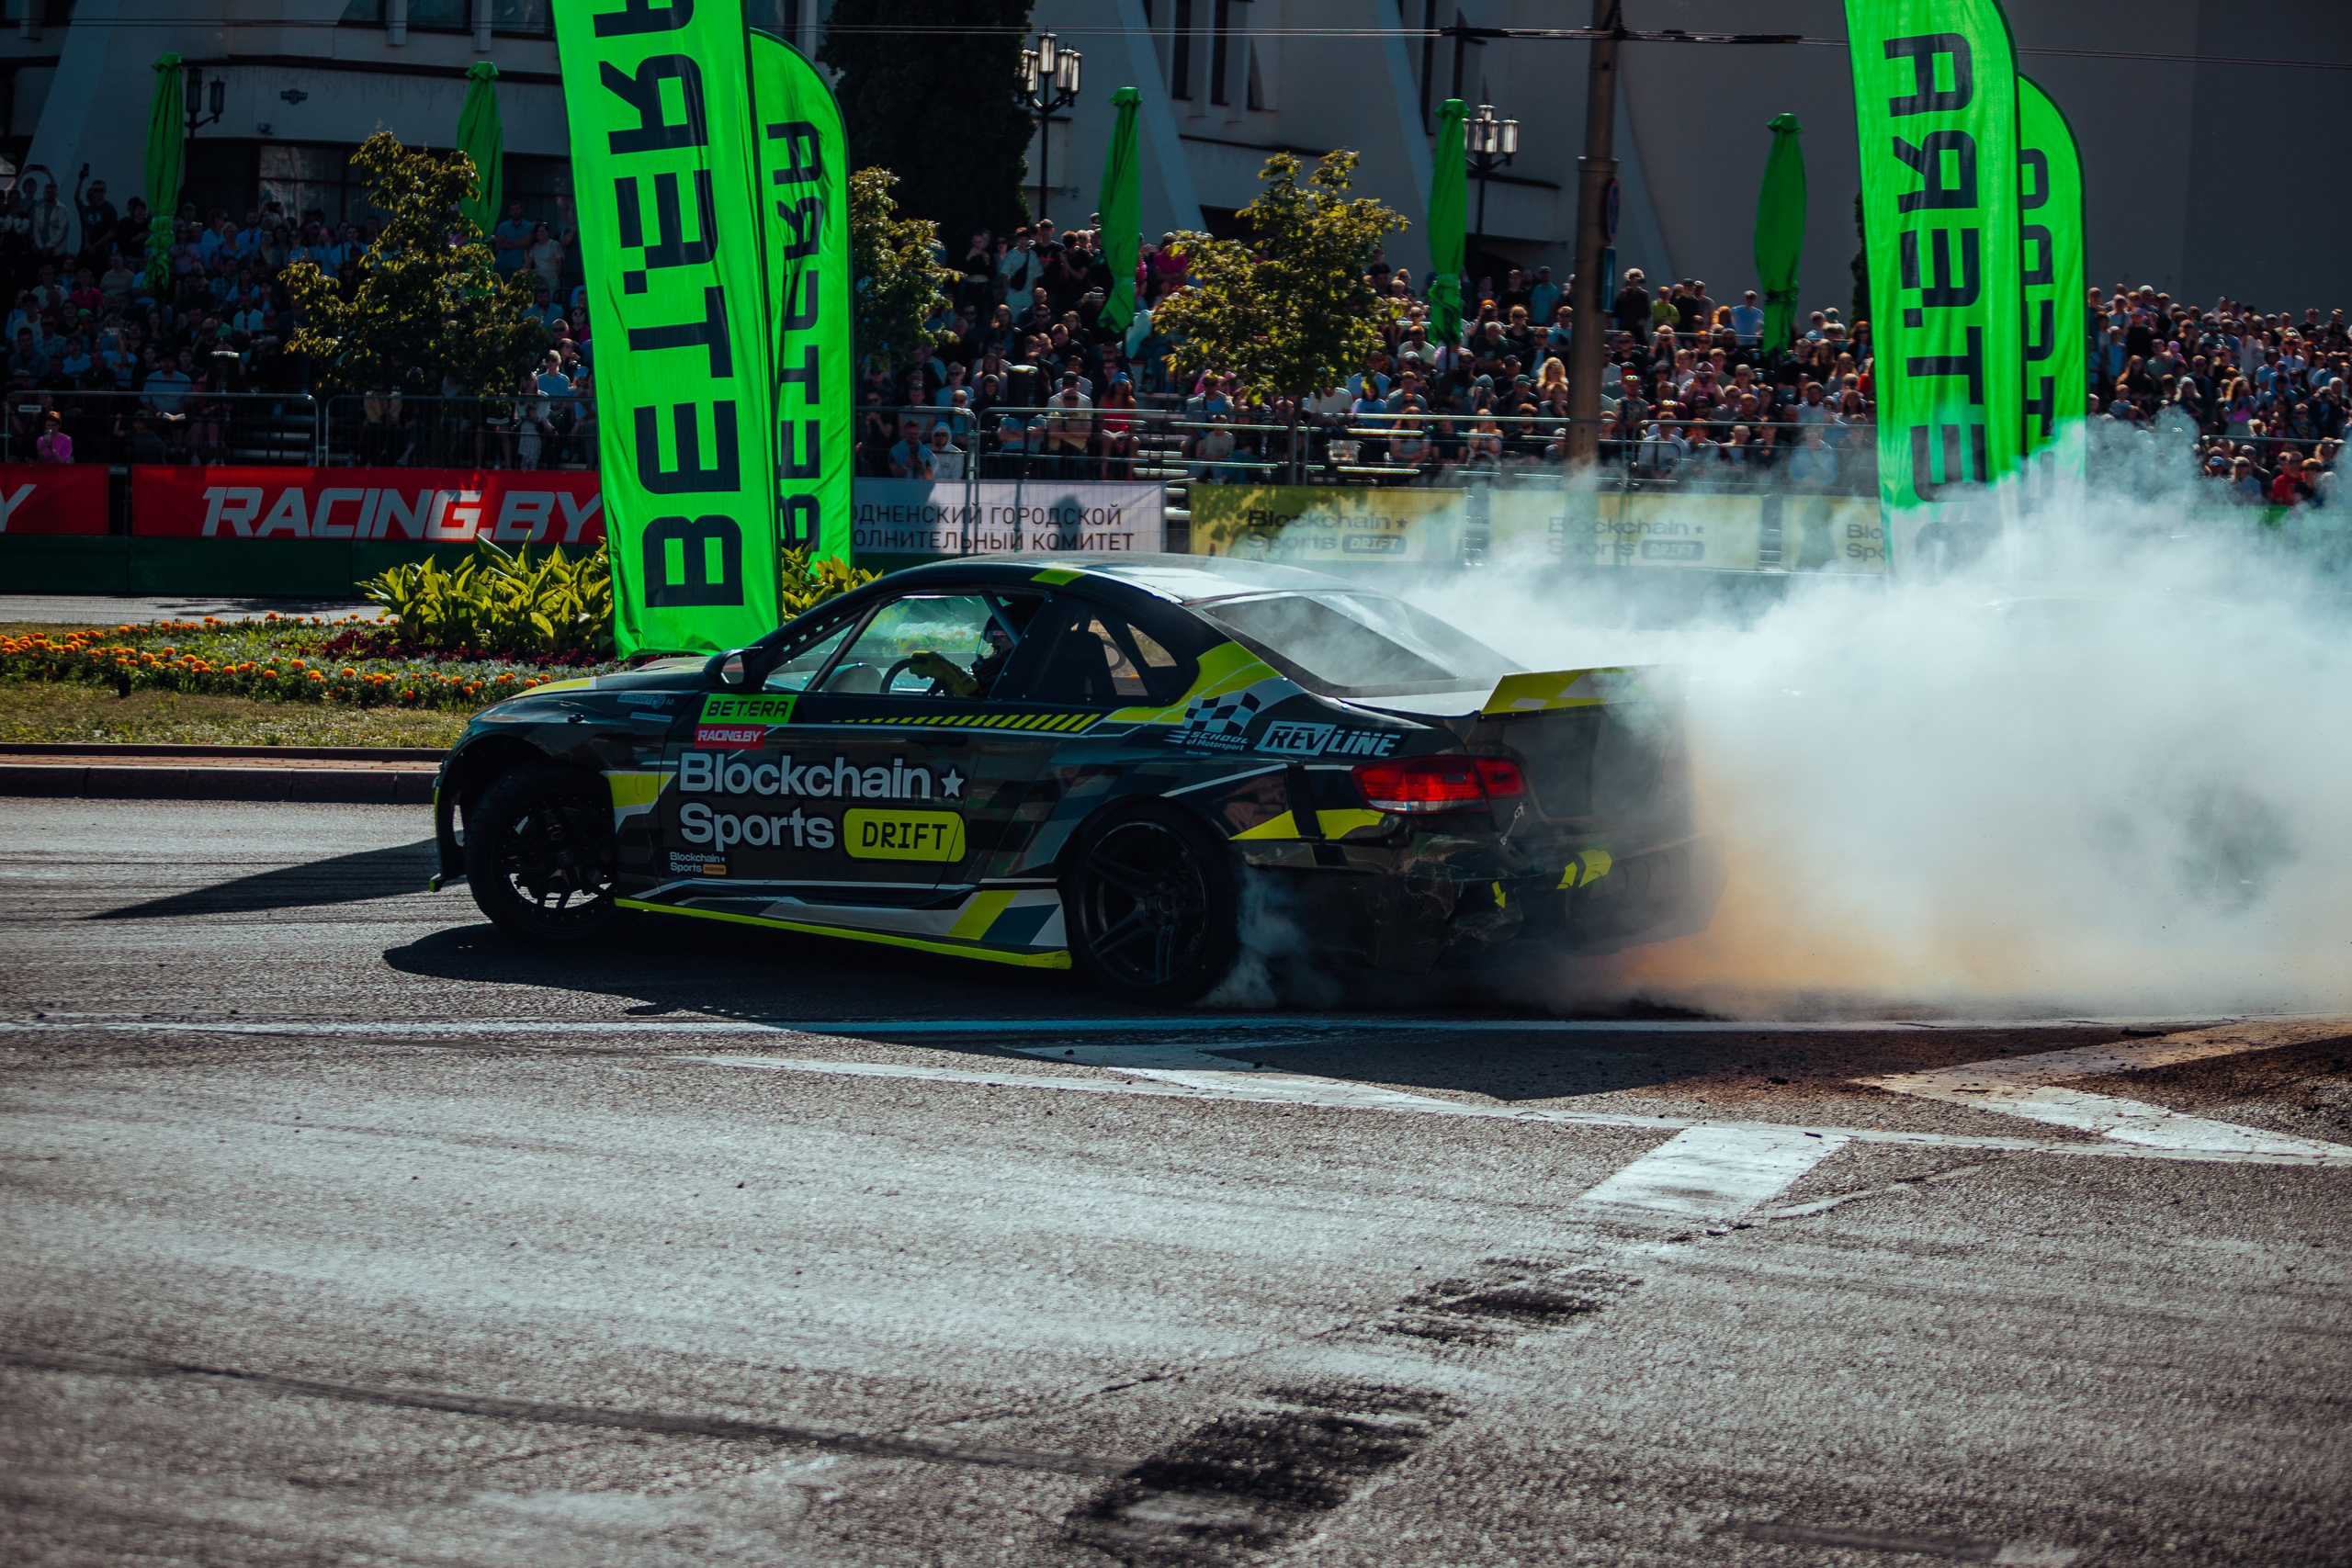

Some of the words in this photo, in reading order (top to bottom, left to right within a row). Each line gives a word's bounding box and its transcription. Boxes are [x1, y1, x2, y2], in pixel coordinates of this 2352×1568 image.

[201, 486, 602, 543] RACING.BY
[990, 504, 1122, 527] ГОРОДСКОЙ
[1248, 510, 1391, 530] Blockchain
[1547, 516, 1690, 536] Blockchain
[1032, 532, 1135, 551] КОМИТЕТ
[1247, 531, 1338, 553] Sports
[1350, 538, 1399, 550] DRIFT
[706, 700, 789, 717] BET.ERA
[697, 729, 762, 742] RACING.BY
[1190, 731, 1249, 744] SCHOOL
[1197, 739, 1245, 751] Motorsport
[679, 751, 931, 800] Blockchain
[679, 803, 835, 852] Sports
[862, 821, 948, 851] DRIFT
[670, 852, 720, 863] Blockchain
[670, 862, 703, 873] Sports
